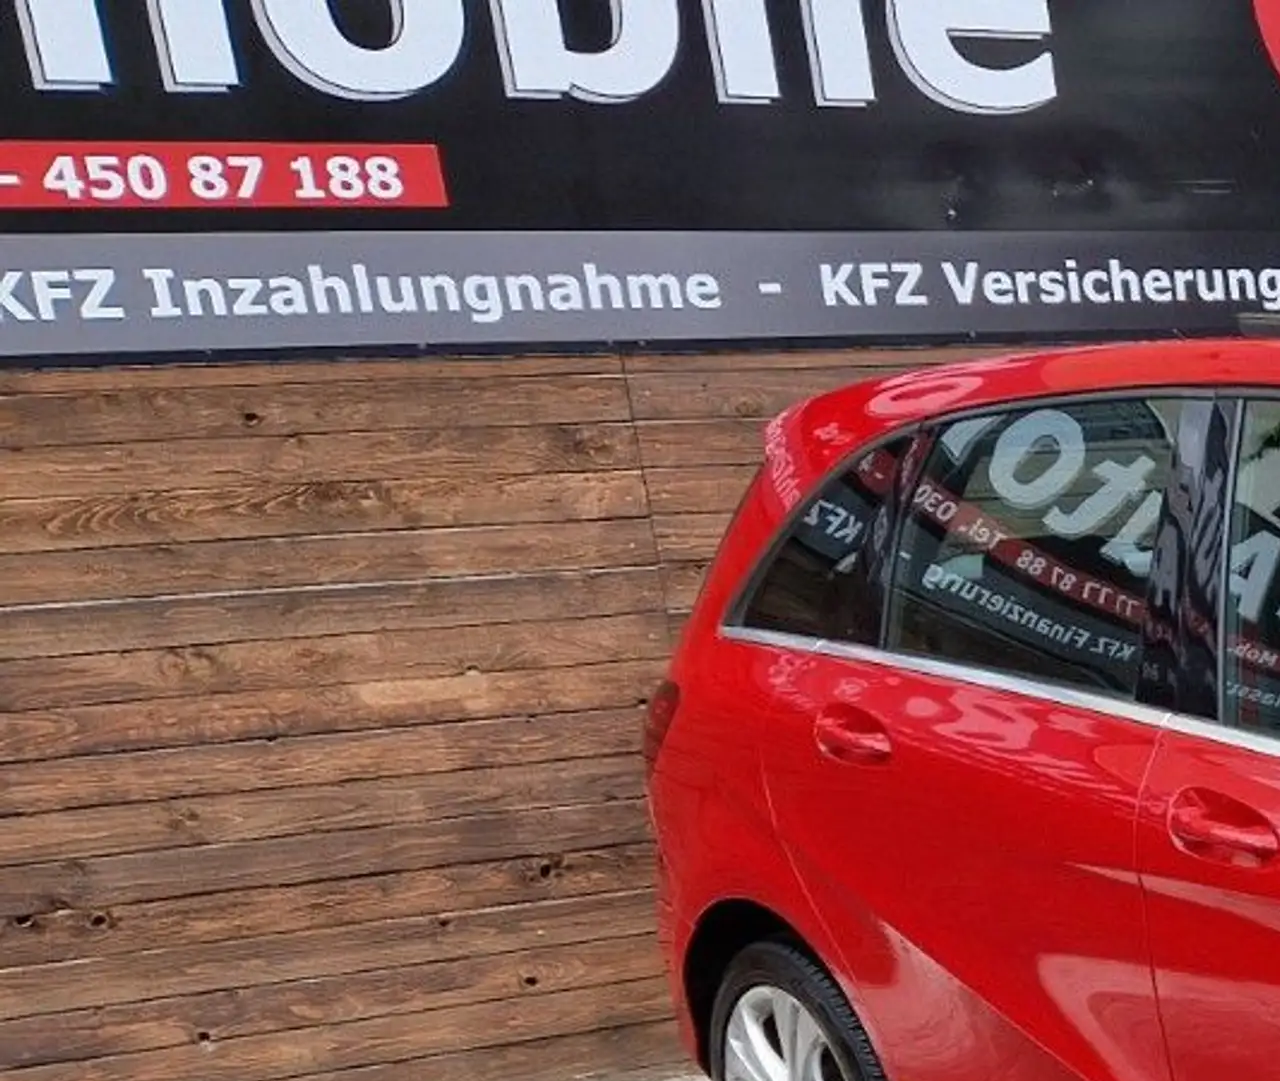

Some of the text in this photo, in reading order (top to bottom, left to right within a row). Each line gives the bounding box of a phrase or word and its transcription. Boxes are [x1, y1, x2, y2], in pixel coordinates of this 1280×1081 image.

[43, 155, 167, 200] 450
[186, 155, 263, 200] 87
[290, 155, 403, 200] 188
[142, 263, 721, 323] Inzahlungnahme
[820, 263, 927, 306] KFZ
